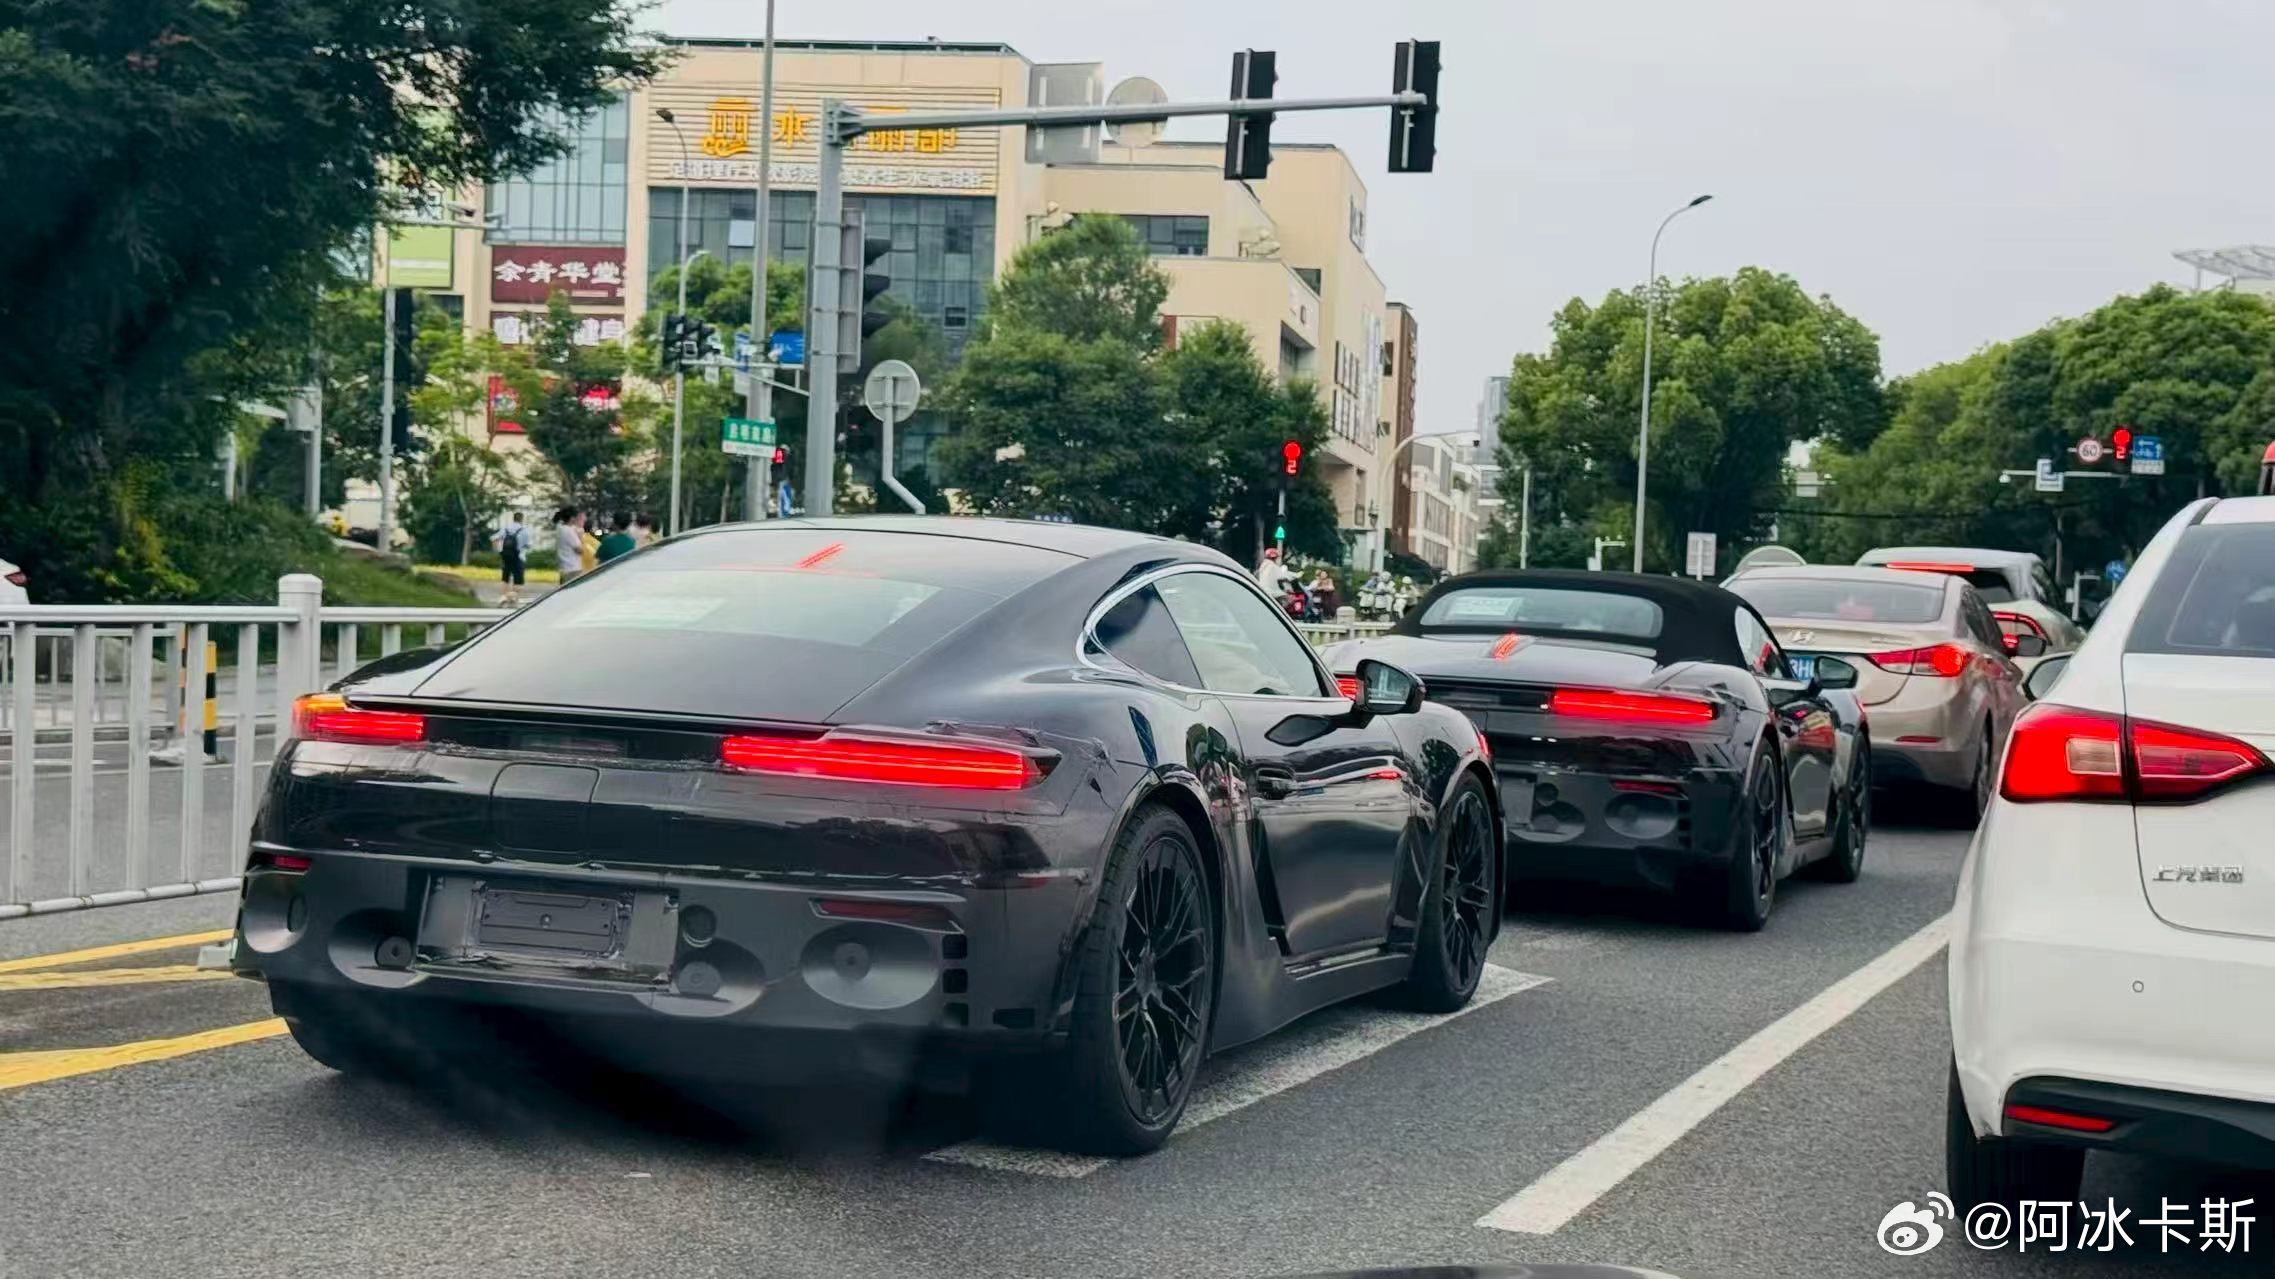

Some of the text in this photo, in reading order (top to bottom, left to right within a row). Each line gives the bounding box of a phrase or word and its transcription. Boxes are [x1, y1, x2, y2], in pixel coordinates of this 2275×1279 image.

[494, 259, 625, 285] 余青华堂
[2083, 444, 2097, 457] 60
[2116, 446, 2126, 459] 2
[1286, 460, 1297, 474] 2
[2152, 865, 2244, 884] 上汽集团
